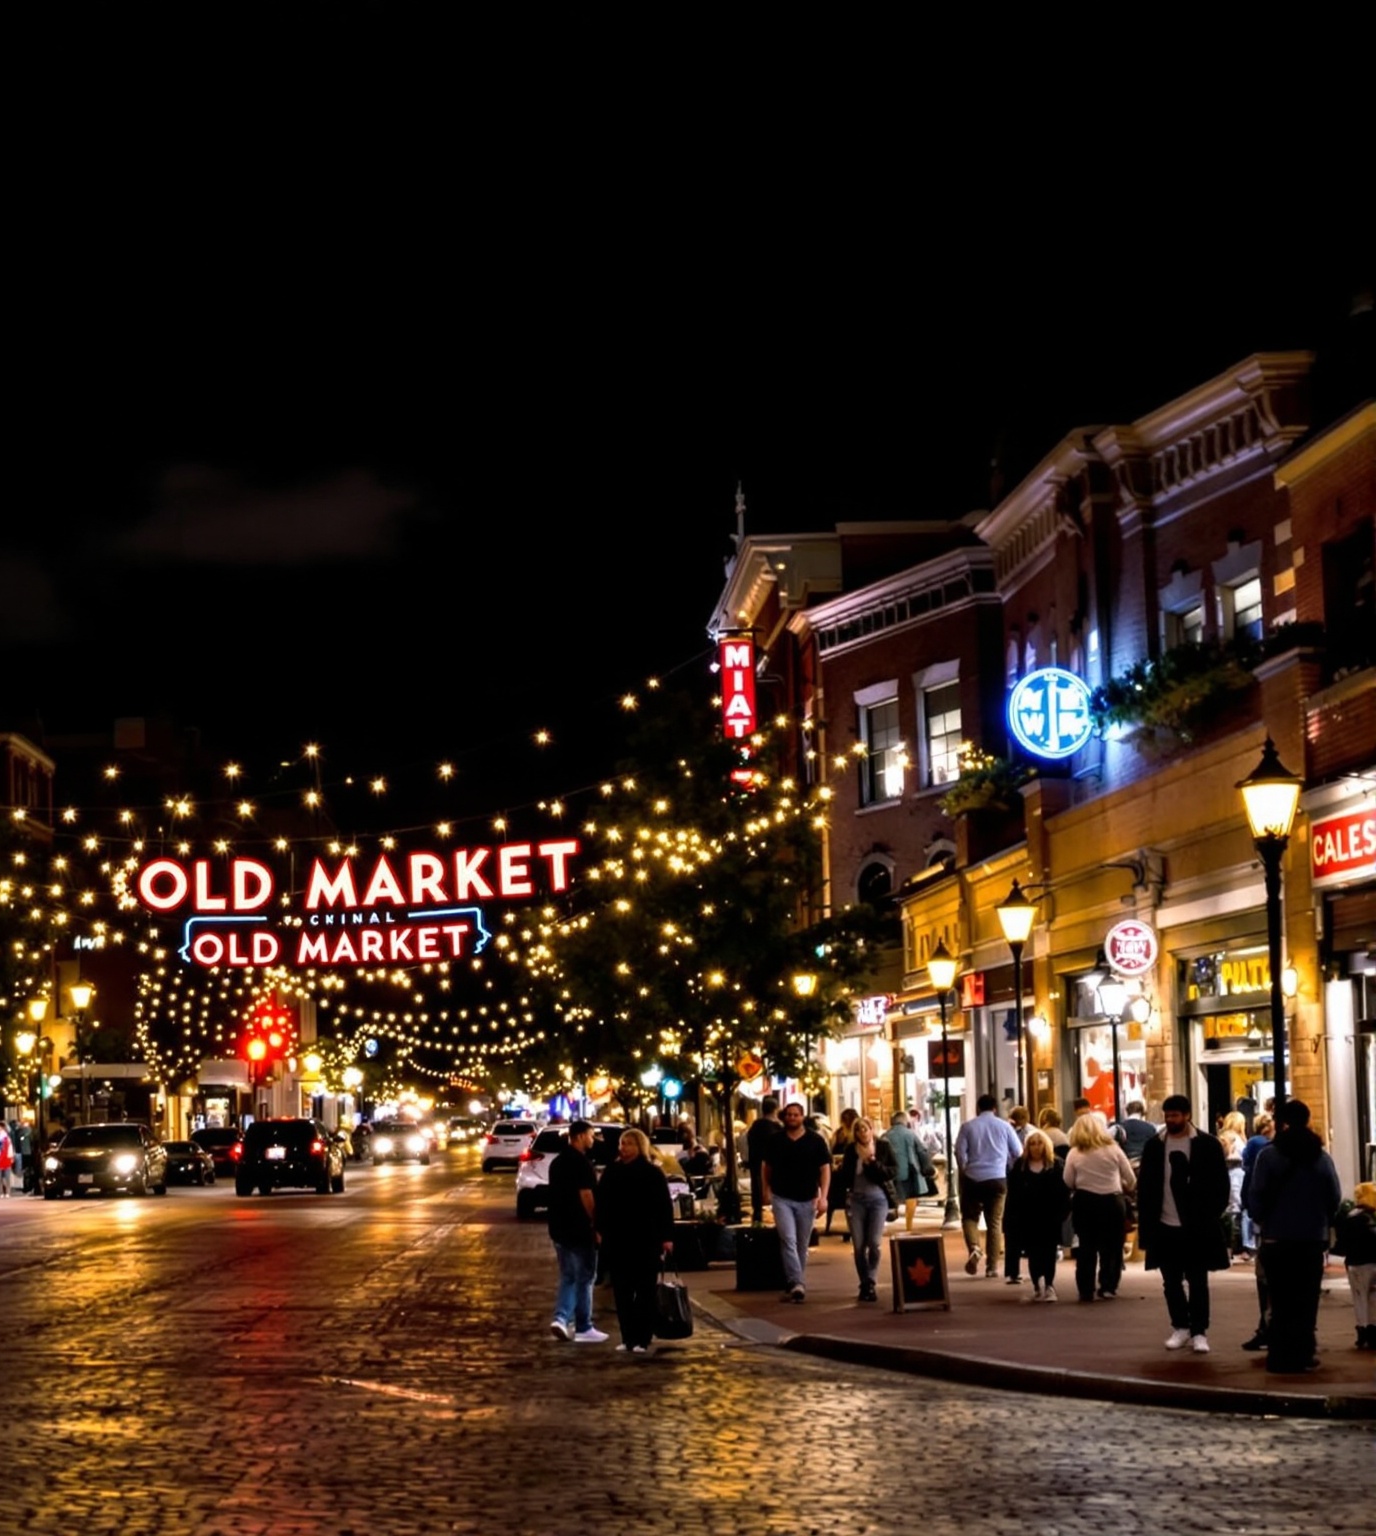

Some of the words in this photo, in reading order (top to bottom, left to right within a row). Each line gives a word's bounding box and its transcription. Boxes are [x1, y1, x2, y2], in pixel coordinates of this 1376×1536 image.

[139, 858, 273, 911] OLD
[307, 841, 578, 909] MARKET
[193, 932, 279, 966] OLD
[297, 924, 469, 965] MARKET
